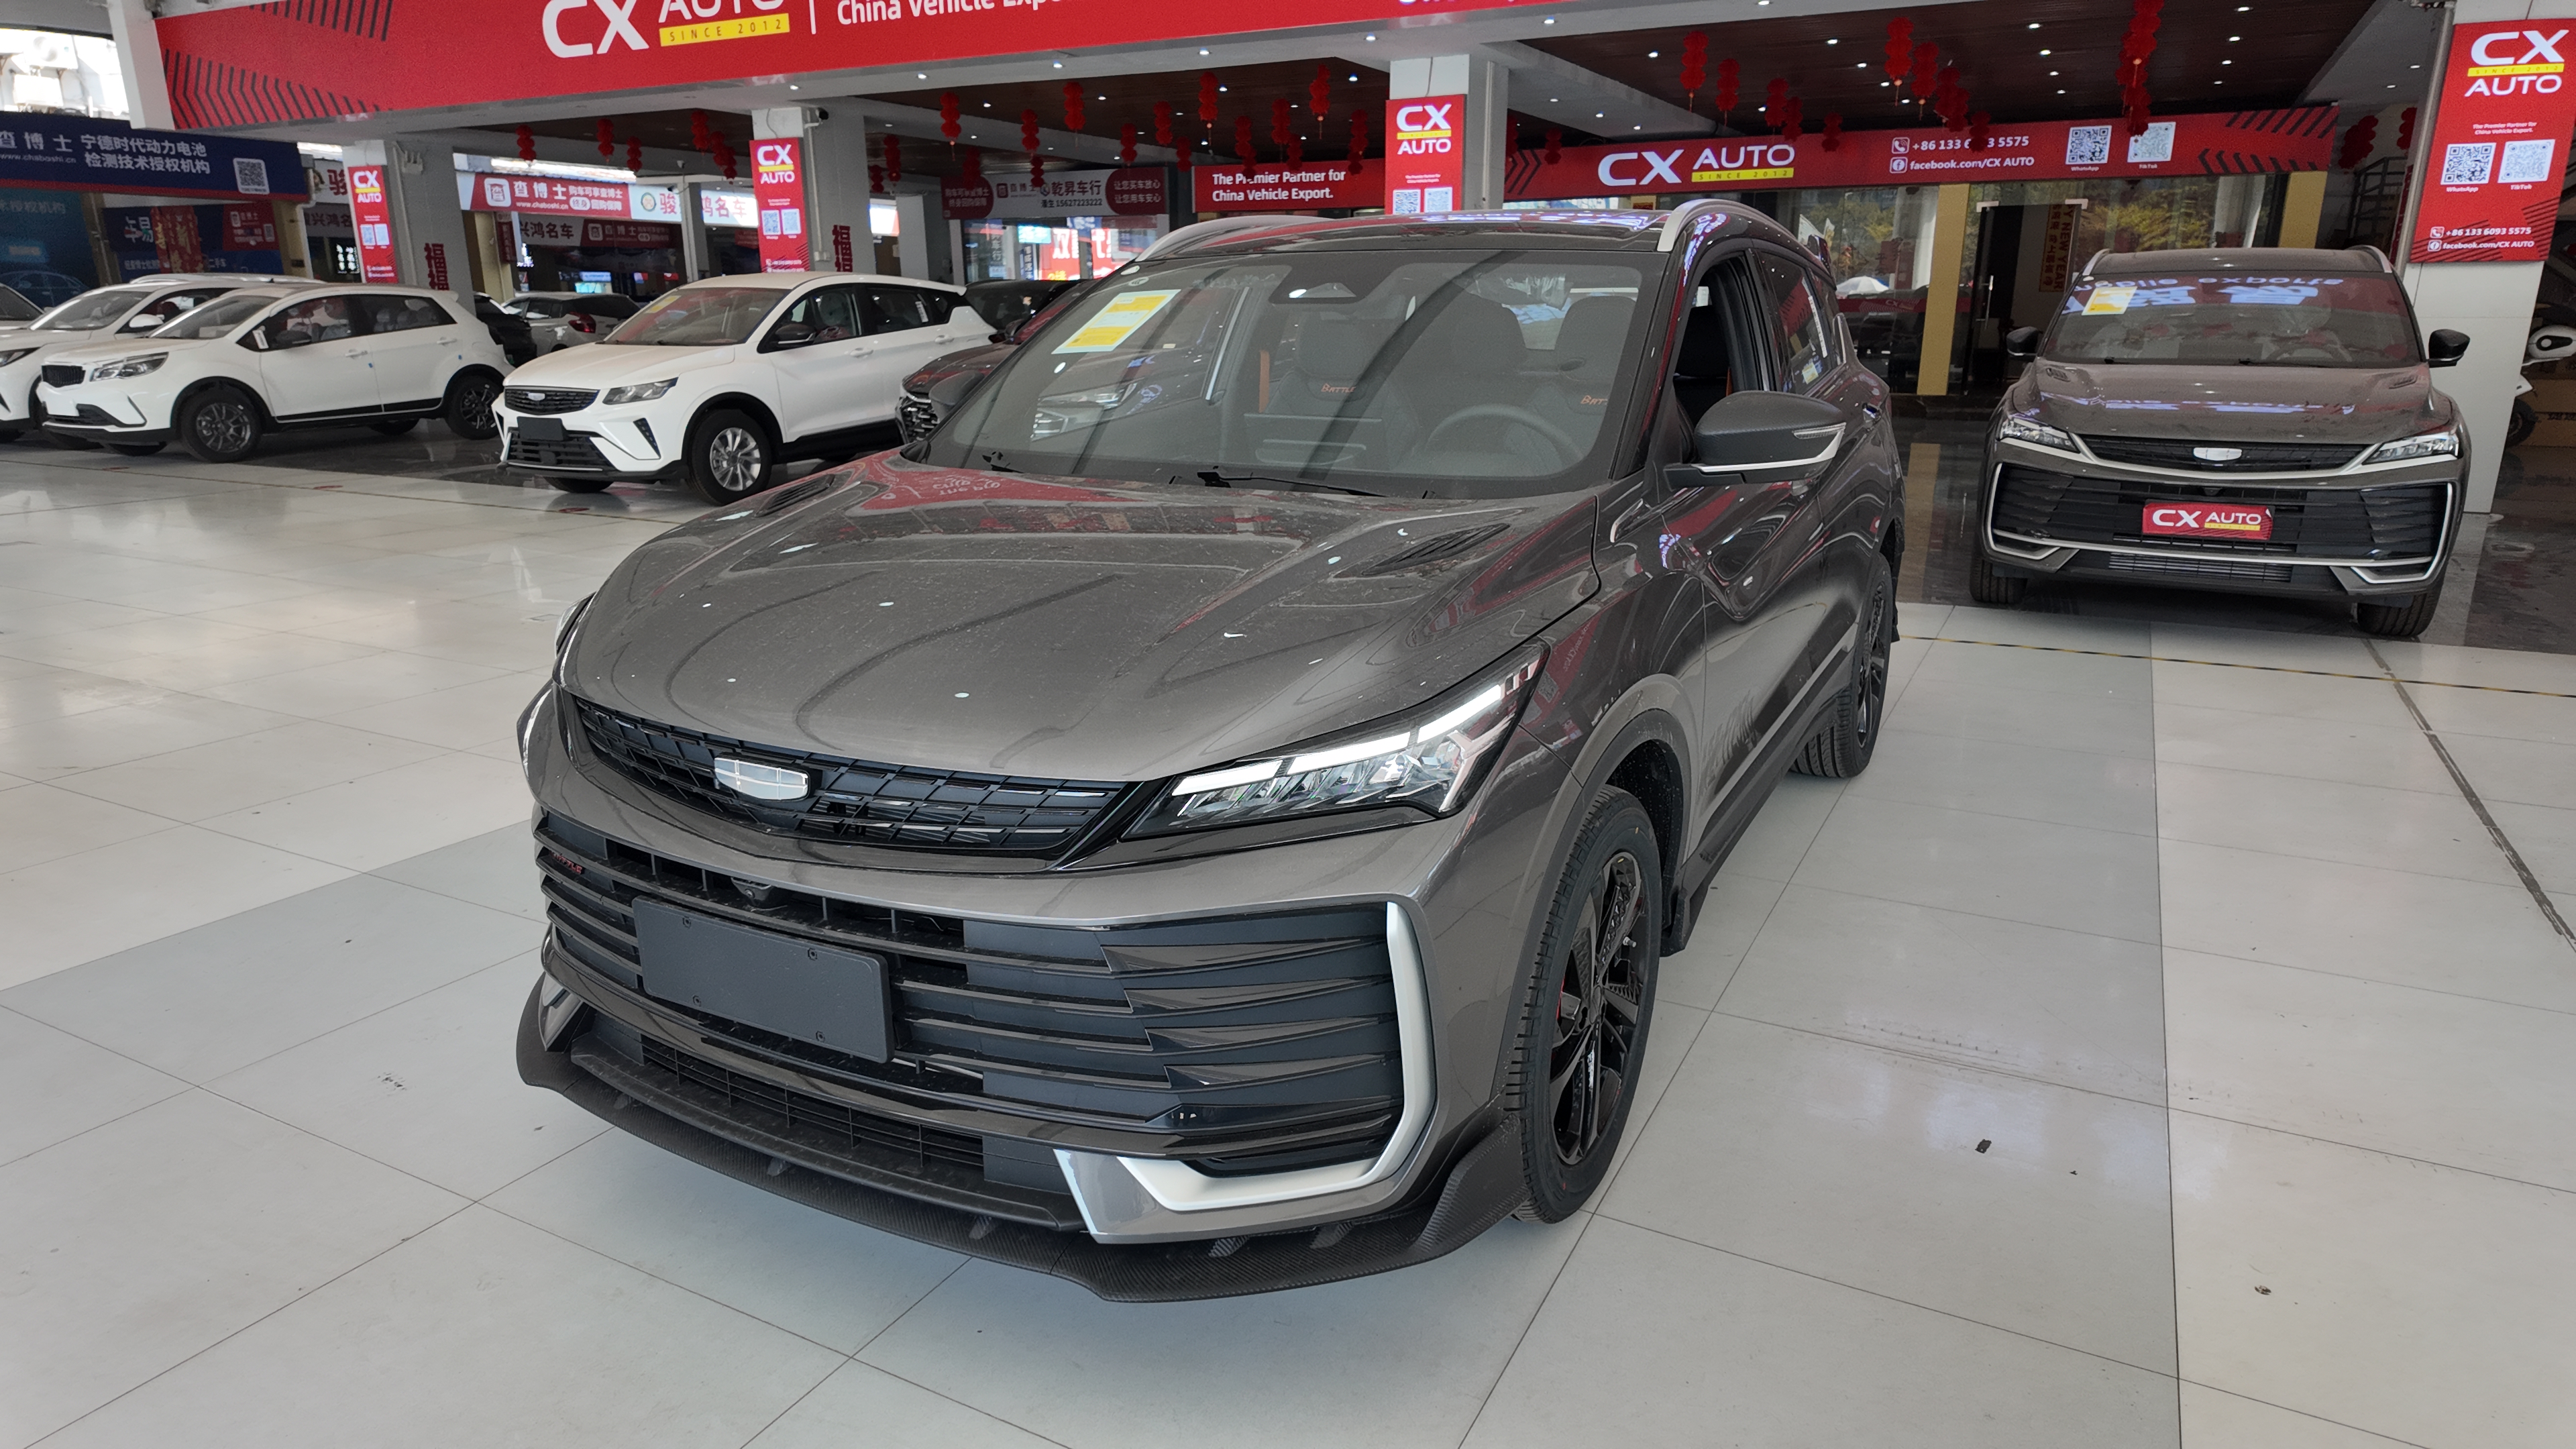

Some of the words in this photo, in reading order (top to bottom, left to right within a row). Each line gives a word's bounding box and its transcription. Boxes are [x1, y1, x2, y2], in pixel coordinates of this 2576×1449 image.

[837, 0, 902, 25] China
[542, 0, 649, 58] CX
[669, 27, 722, 42] SINCE
[738, 19, 782, 34] 2012
[2470, 29, 2570, 66] CX
[2464, 74, 2563, 97] AUTO
[1396, 103, 1452, 132] CX
[80, 134, 207, 157] 宁德时代动力电池
[1397, 138, 1452, 155] AUTO
[1912, 141, 1936, 151] +86
[1939, 139, 1962, 150] 133
[1964, 138, 1995, 149] 63
[1998, 136, 2029, 148] 5575
[85, 152, 211, 174] 检测技术授权机构
[757, 144, 794, 166] CX
[1597, 149, 1684, 186] CX
[1693, 144, 1795, 170] AUTO
[1910, 158, 2002, 170] facebook.com/CX
[2003, 157, 2035, 167] AUTO
[353, 170, 380, 188] CX
[760, 171, 796, 184] AUTO
[1212, 173, 1233, 185] The
[1283, 170, 1327, 183] Partner
[1328, 169, 1346, 182] for
[1699, 172, 1741, 180] SINCE
[1753, 169, 1788, 178] 2012
[357, 192, 382, 203] AUTO
[513, 180, 567, 201] 查博士
[1212, 190, 1244, 202] China
[1246, 188, 1289, 201] Vehicle
[1291, 187, 1334, 201] Export.
[2059, 221, 2072, 252] NEW
[2483, 227, 2506, 235] 6093
[2508, 227, 2532, 235] 5575
[2443, 241, 2510, 250] facebook.com/CX
[1321, 383, 1356, 393] BATTLE
[2151, 508, 2202, 529] CX
[2205, 511, 2261, 525] AUTO
